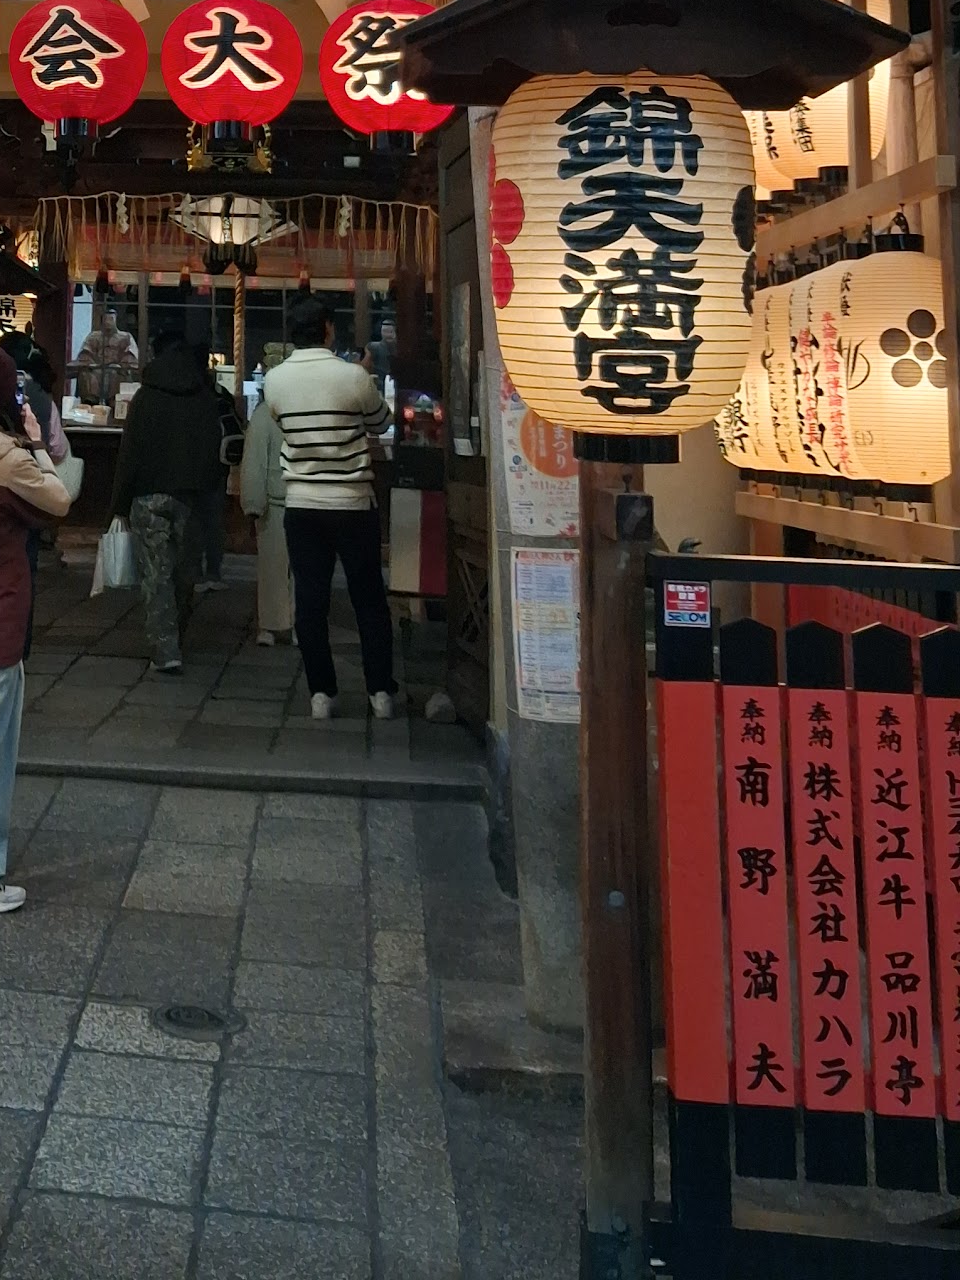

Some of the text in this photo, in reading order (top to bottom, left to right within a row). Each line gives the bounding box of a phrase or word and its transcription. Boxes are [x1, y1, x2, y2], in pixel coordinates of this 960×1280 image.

[25, 9, 120, 87] 会
[185, 11, 277, 86] 大
[555, 84, 704, 415] 錦天満宮
[739, 697, 766, 746] 奉納
[807, 701, 834, 750] 奉納
[875, 705, 903, 754] 奉納
[734, 756, 787, 1094] 南野満夫
[802, 761, 854, 1097] 株式会社カハラ
[870, 767, 924, 1107] 近江牛 品川亭
